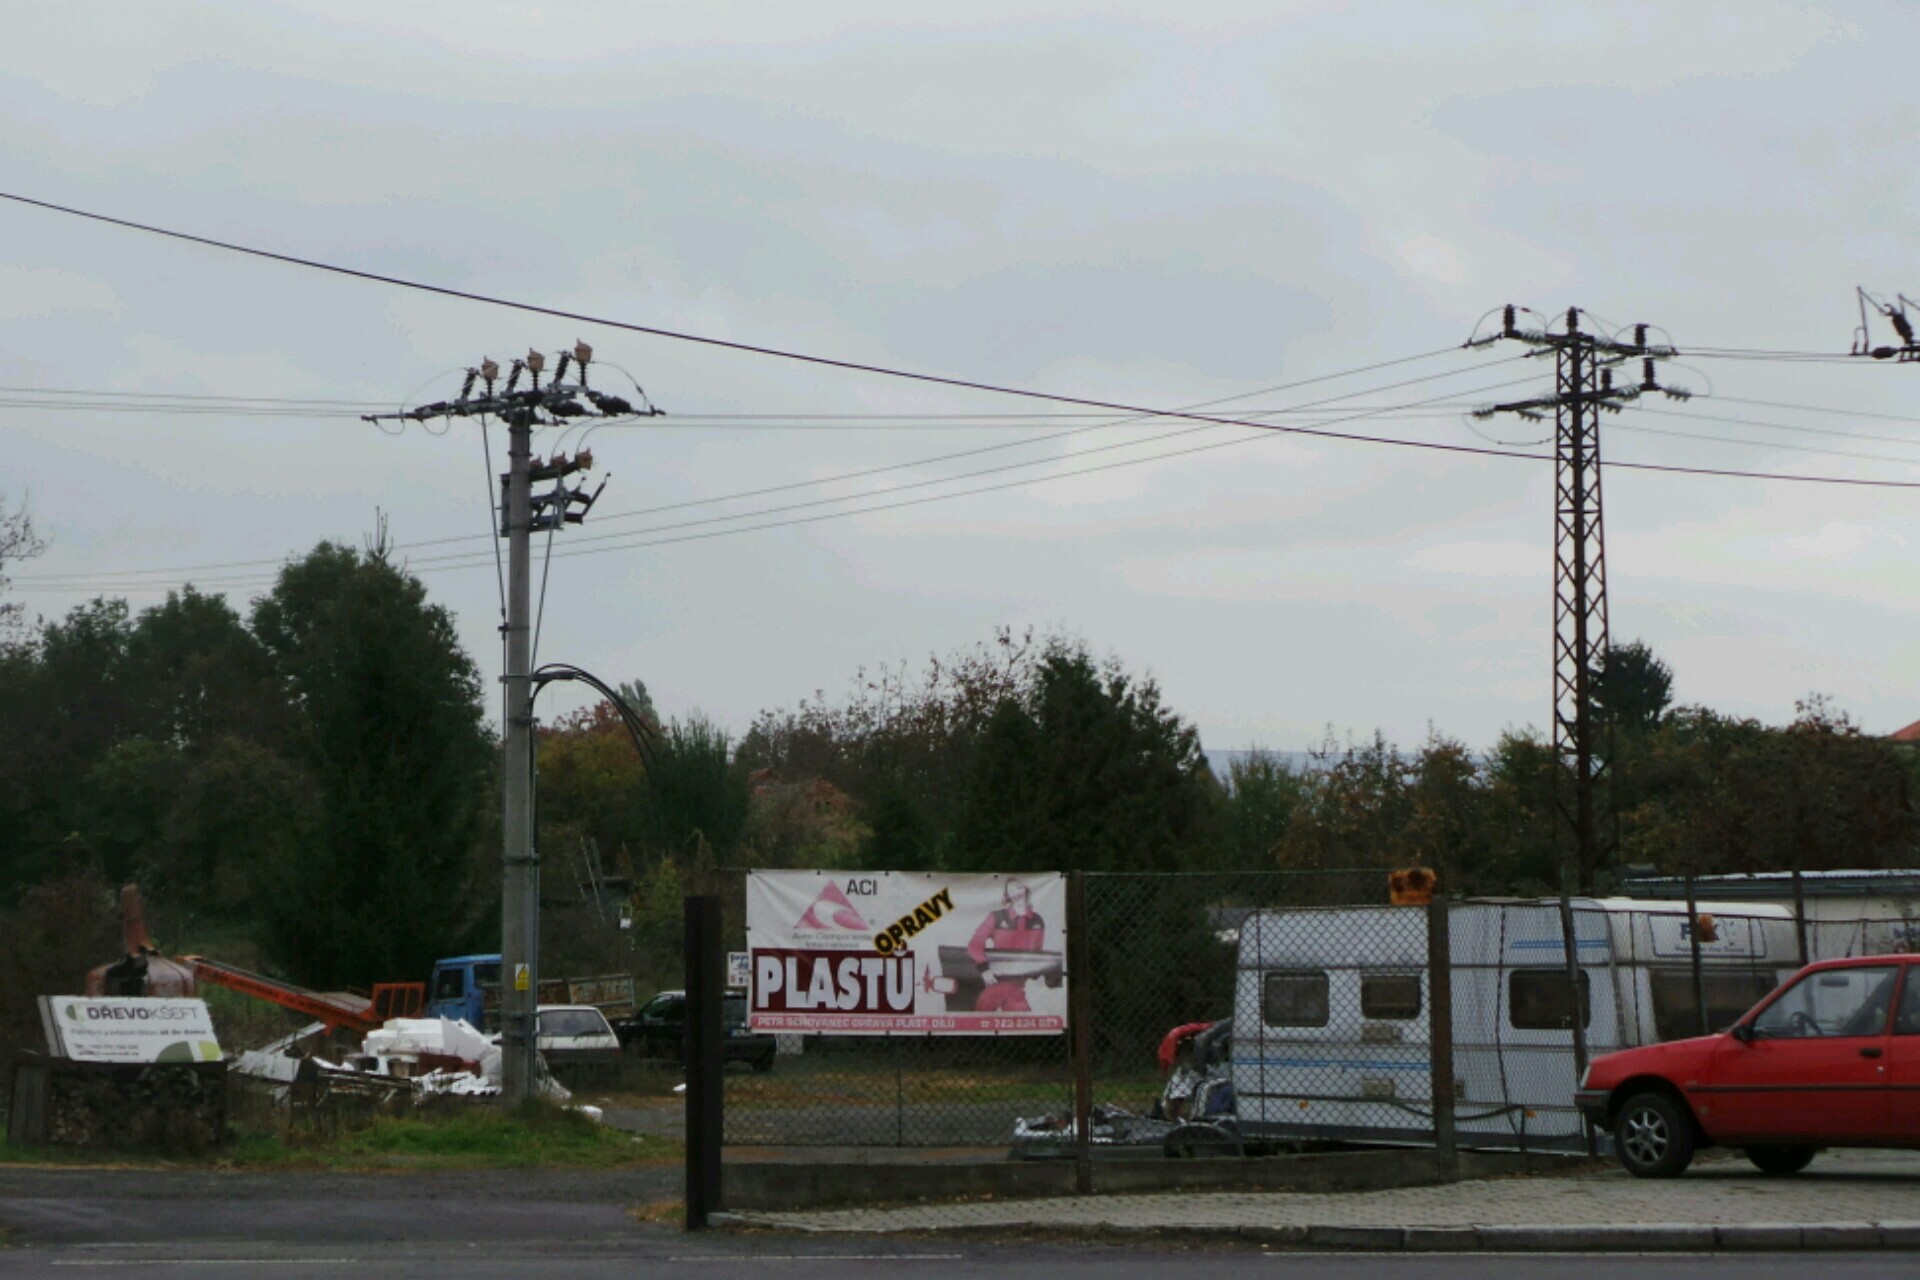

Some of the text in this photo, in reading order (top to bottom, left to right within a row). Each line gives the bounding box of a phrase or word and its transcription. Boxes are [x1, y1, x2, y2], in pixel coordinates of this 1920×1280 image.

[845, 878, 878, 896] ACI
[873, 886, 956, 956] OPRAVY
[756, 942, 915, 1012] PLASTŮ
[757, 1016, 785, 1026] PETR
[850, 1017, 894, 1028] OPRAVA
